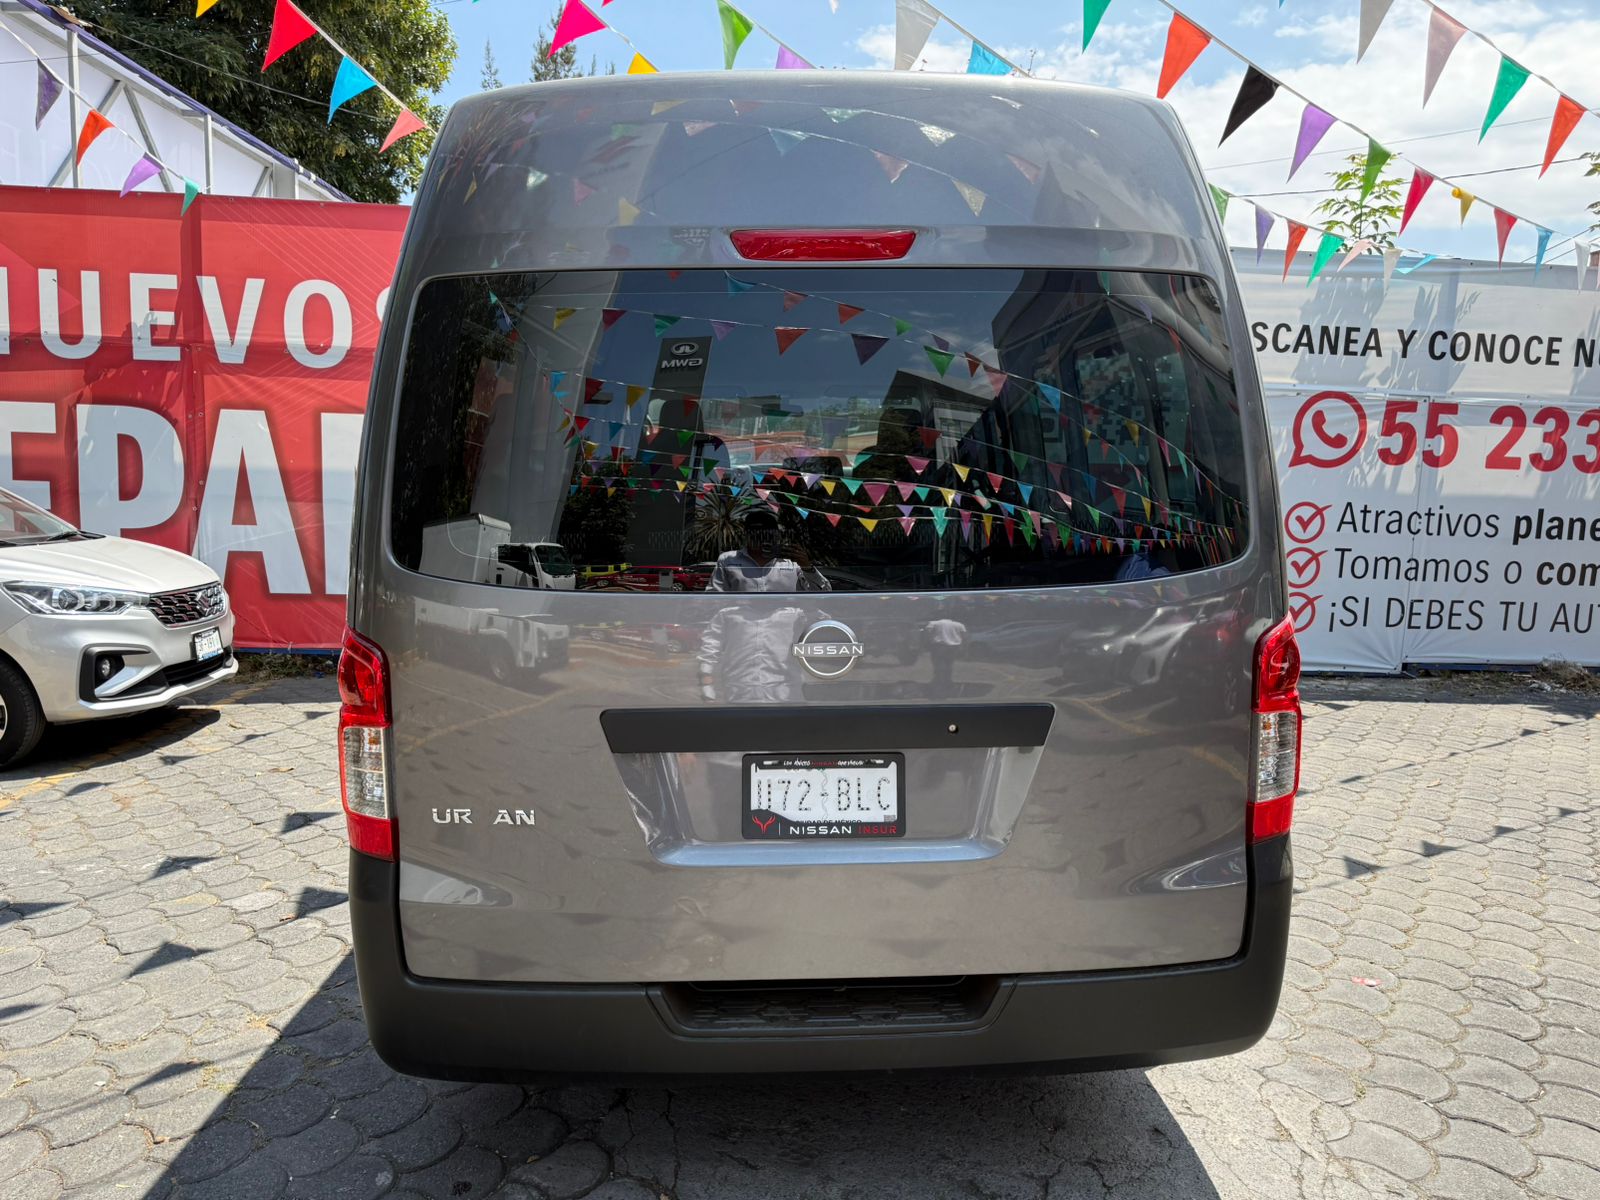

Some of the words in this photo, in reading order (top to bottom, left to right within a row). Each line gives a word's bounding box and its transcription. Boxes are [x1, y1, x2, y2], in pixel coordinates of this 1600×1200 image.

[0, 266, 387, 369] UEVO
[1251, 321, 1382, 357] SCANEA
[1397, 329, 1417, 358] Y
[1428, 330, 1562, 366] CONOCE
[1573, 338, 1600, 368] N
[1377, 400, 1459, 468] 55
[1485, 405, 1600, 474] 233
[1336, 501, 1500, 538] Atractivos
[1334, 548, 1490, 583] Tomamos
[1504, 561, 1522, 584] o
[1328, 596, 1370, 632] ¡SI
[1385, 597, 1485, 631] DEBES
[1499, 601, 1538, 632] TU
[1549, 602, 1600, 634] AU
[794, 645, 863, 655] NISSAN
[790, 825, 852, 835] NISSAN
[858, 825, 897, 834] INSUR
